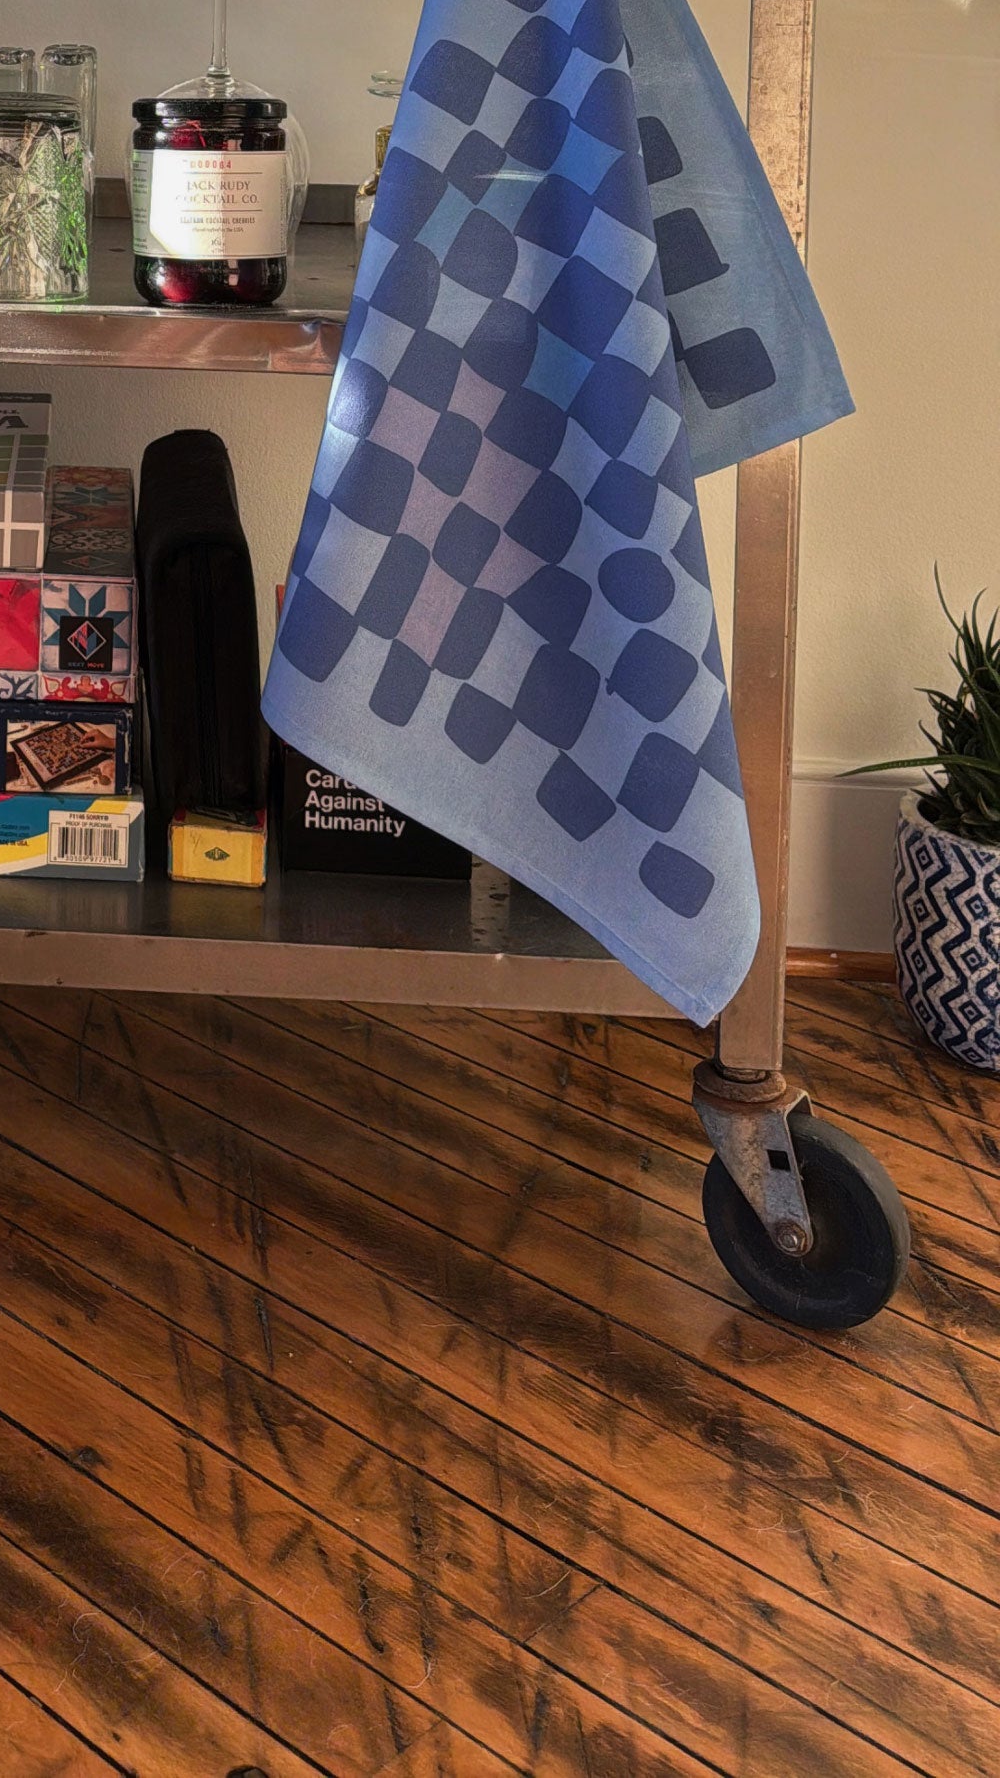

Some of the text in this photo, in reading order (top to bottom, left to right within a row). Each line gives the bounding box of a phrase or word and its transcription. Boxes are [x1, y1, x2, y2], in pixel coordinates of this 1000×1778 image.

[219, 181, 251, 191] RUDY
[305, 769, 357, 790] Car
[304, 789, 385, 813] Against
[304, 810, 406, 837] Humanity
